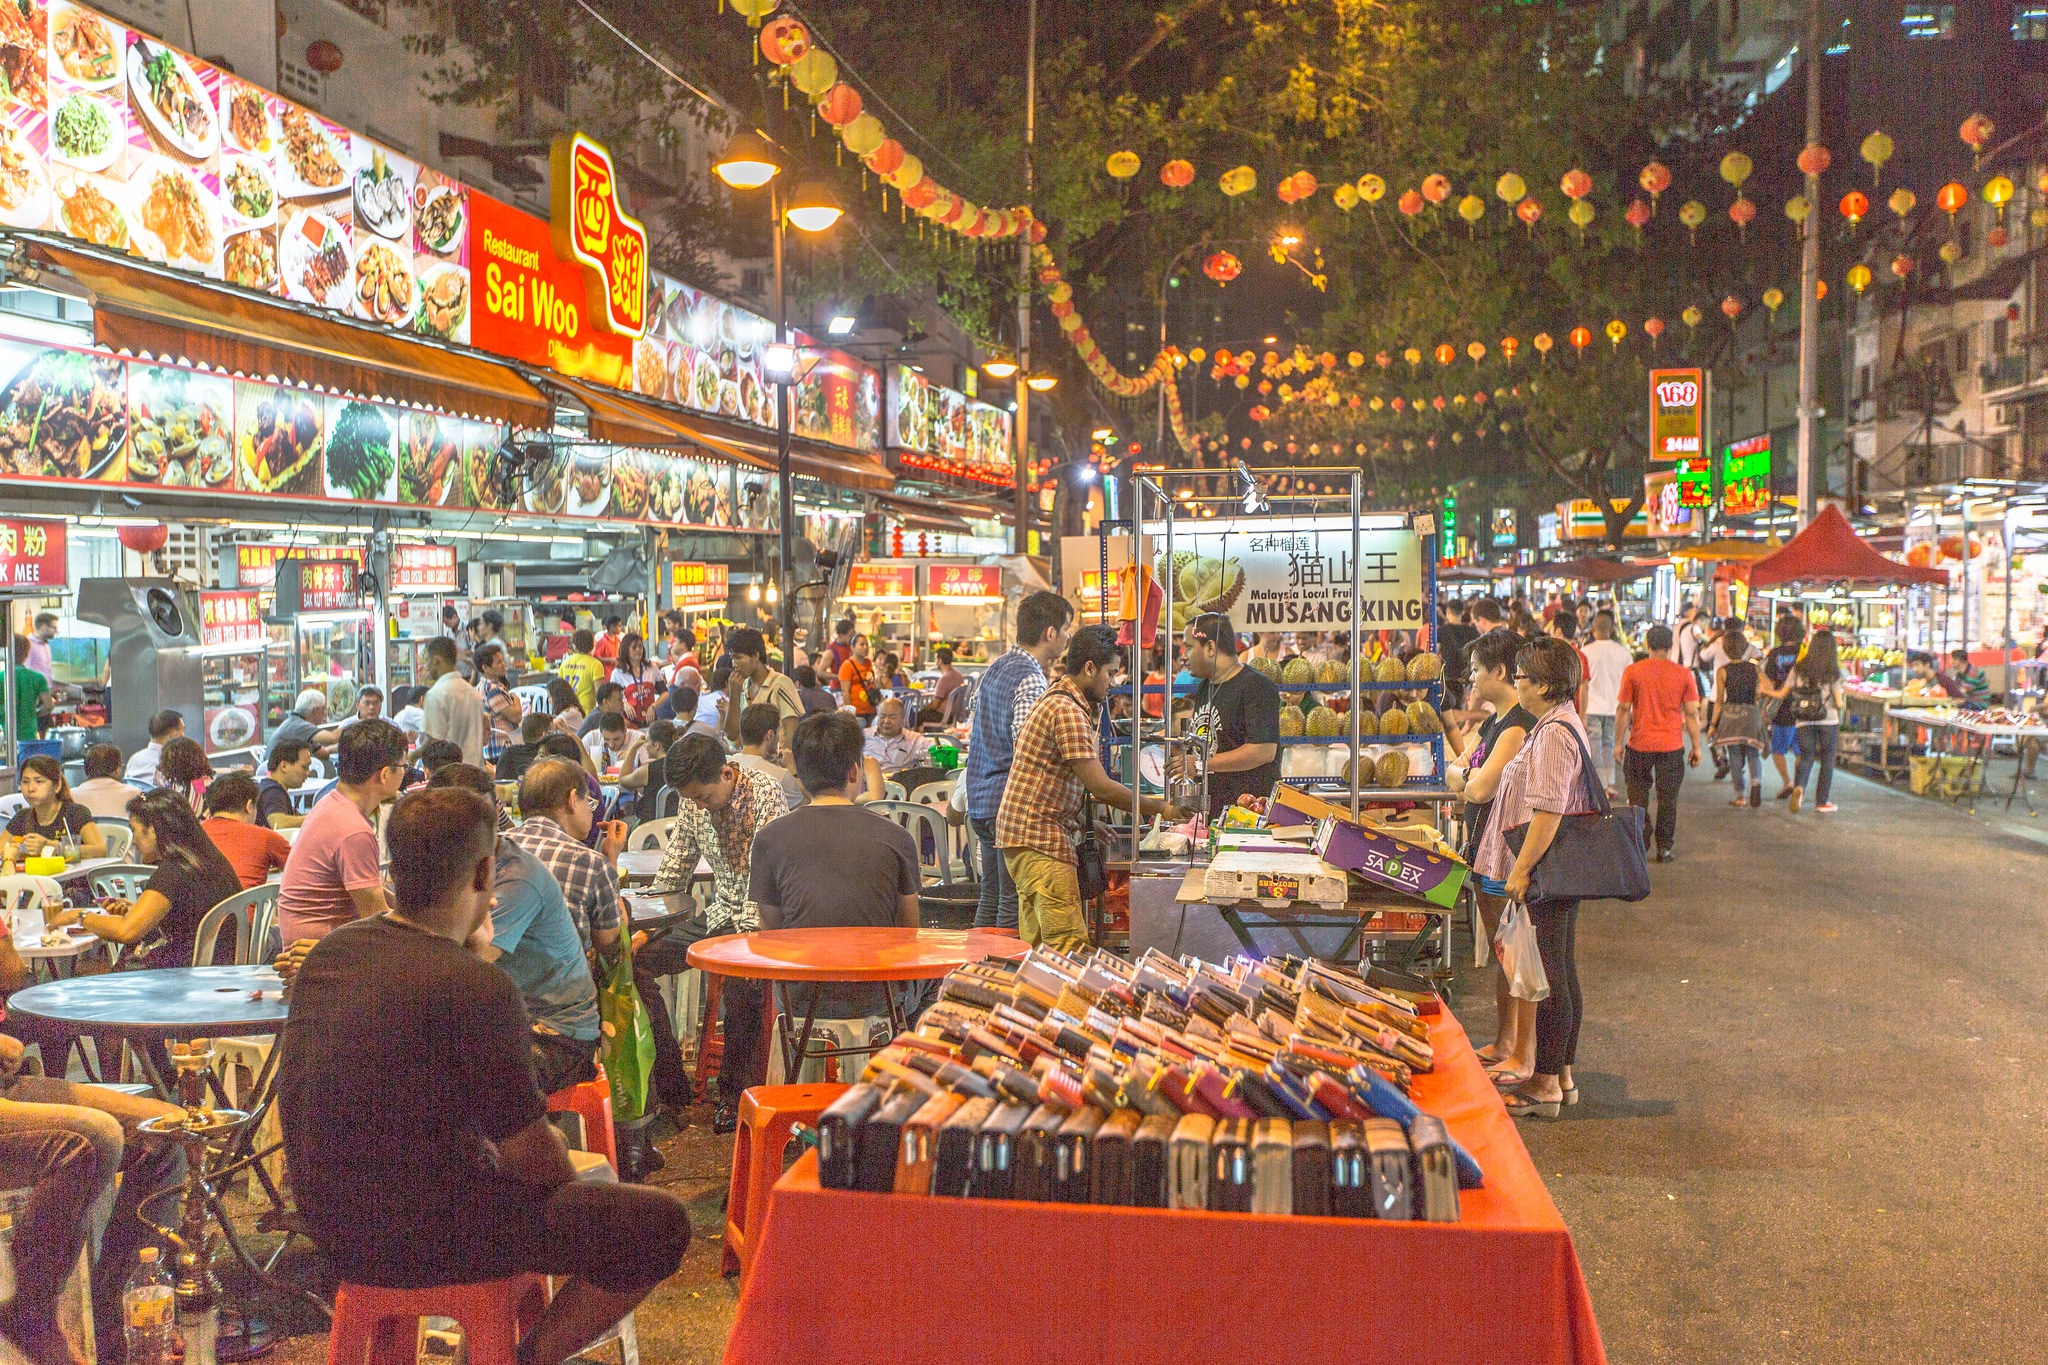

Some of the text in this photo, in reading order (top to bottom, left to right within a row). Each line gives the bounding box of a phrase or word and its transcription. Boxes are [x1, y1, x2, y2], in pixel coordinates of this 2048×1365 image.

[483, 229, 539, 271] Restaurant
[486, 262, 578, 338] Sai Woo
[1659, 384, 1696, 405] 168
[1666, 437, 1682, 451] 24
[1249, 537, 1310, 552] 名种榴莲
[14, 563, 40, 581] MEE
[1289, 551, 1399, 587] 猫山王
[940, 583, 988, 596] SATAY
[1251, 587, 1352, 602] Malaysia Local Frui
[303, 592, 313, 607] BAK
[324, 592, 333, 607] TEH
[1246, 599, 1421, 624] MUSANG KING
[1365, 854, 1422, 884] SAPEX
[1273, 887, 1283, 898] 3
